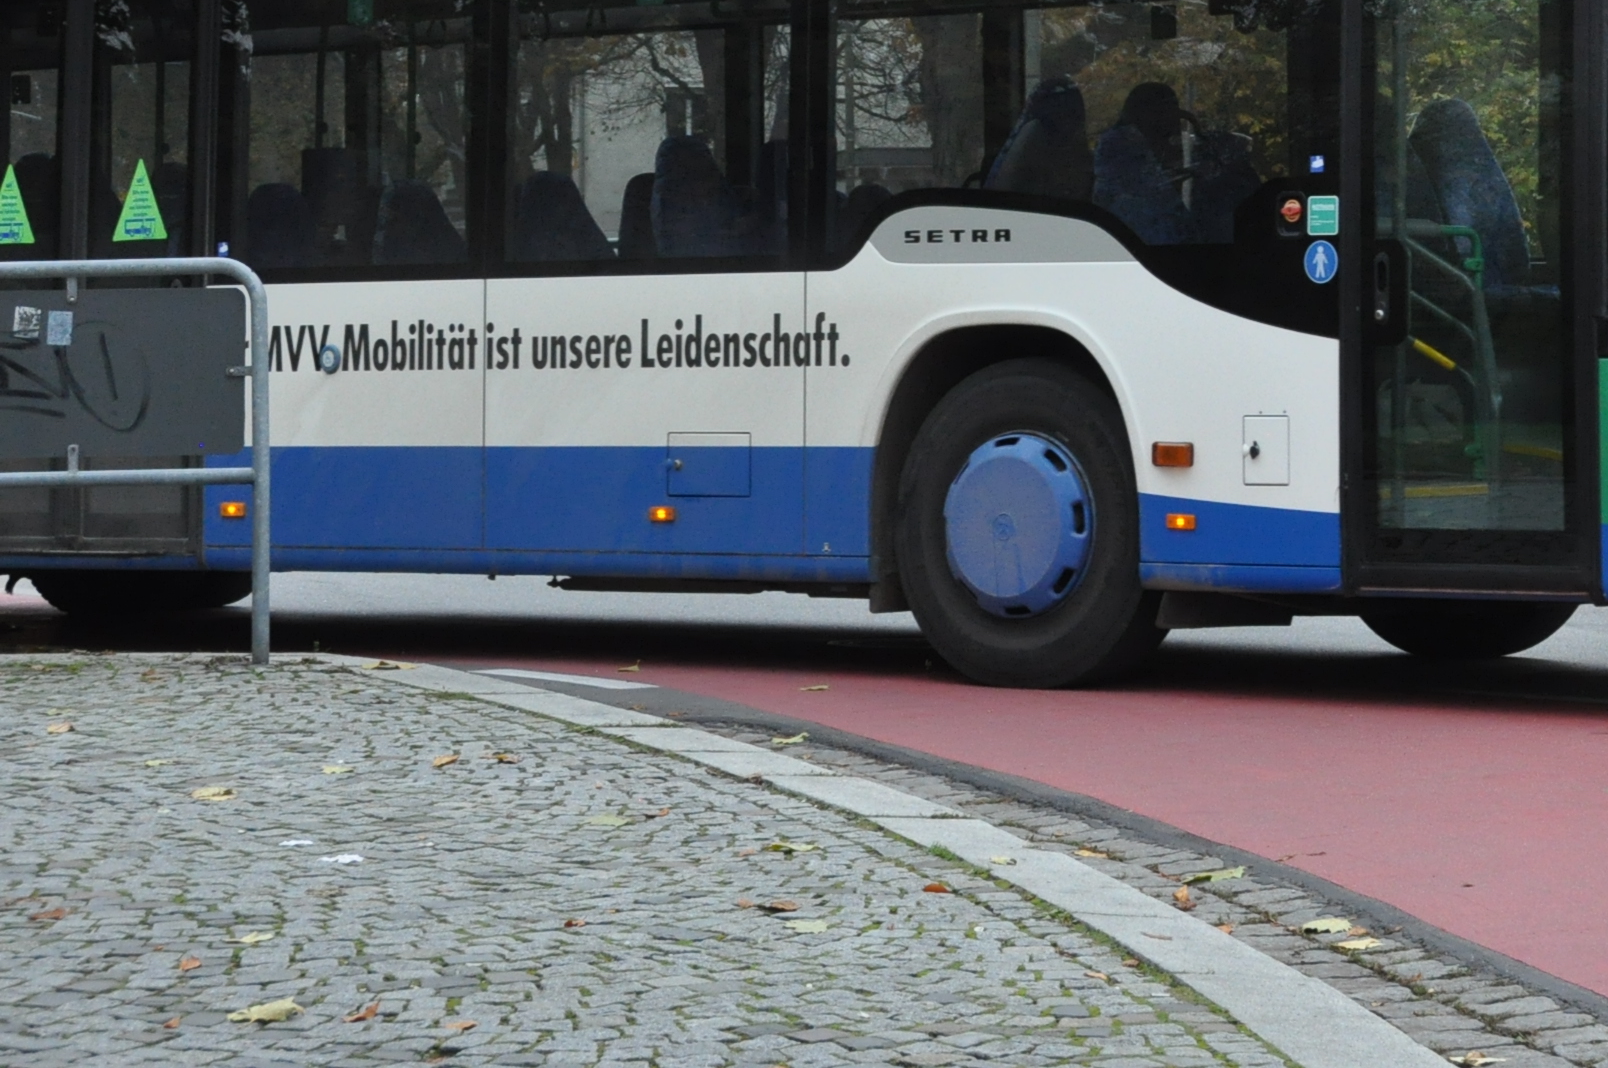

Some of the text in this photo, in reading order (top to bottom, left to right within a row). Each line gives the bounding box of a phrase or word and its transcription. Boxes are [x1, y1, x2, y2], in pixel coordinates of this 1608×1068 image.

[904, 229, 1011, 244] SETRA
[341, 319, 478, 371] Mobilität
[486, 322, 522, 369] ist
[531, 333, 632, 369] unsere
[640, 311, 851, 368] Leidenschaft.
